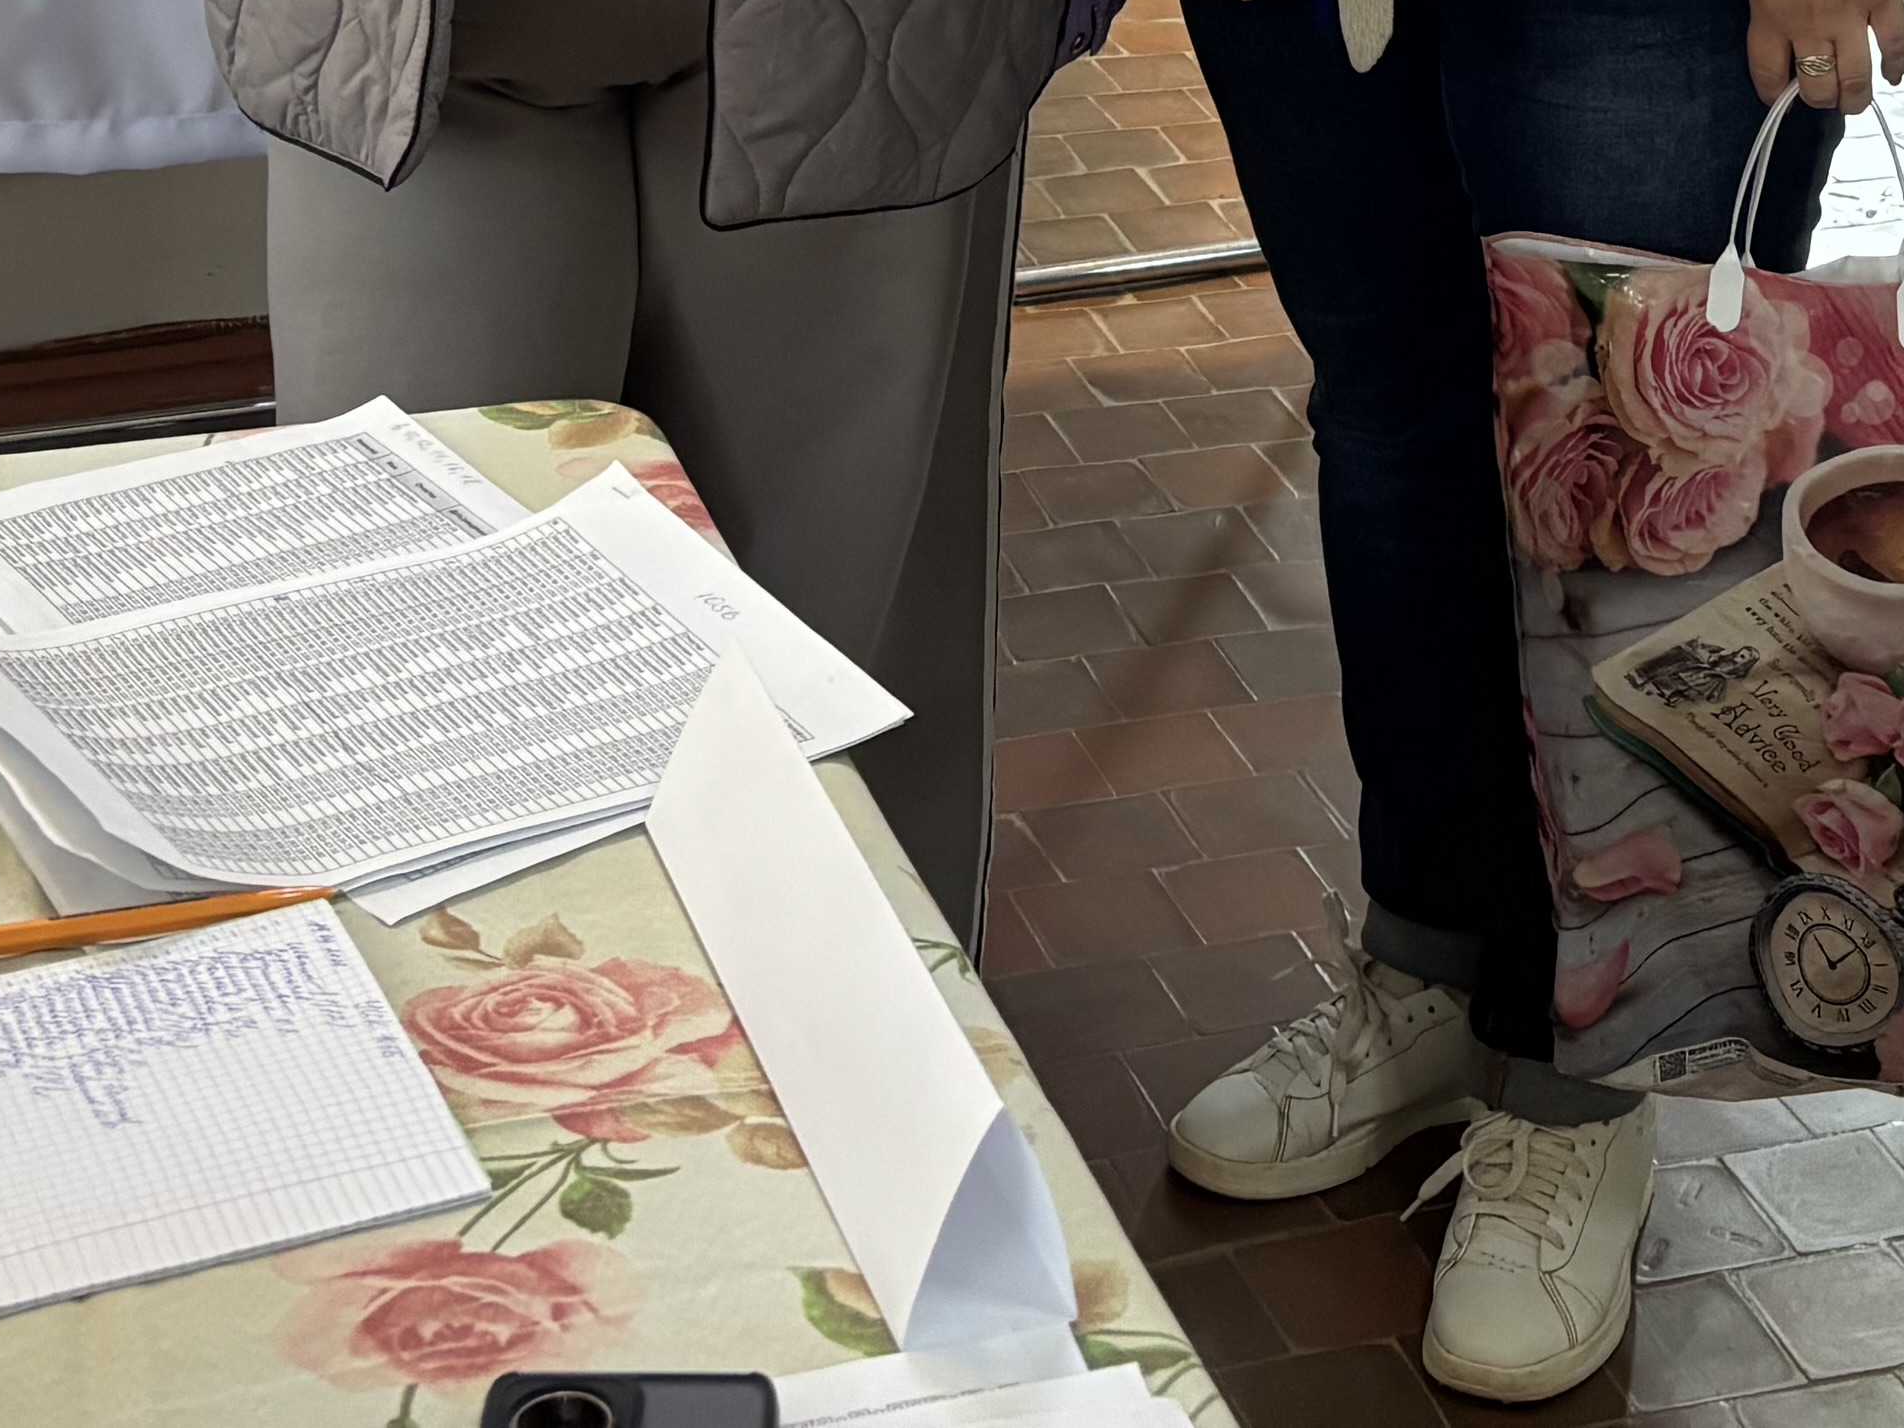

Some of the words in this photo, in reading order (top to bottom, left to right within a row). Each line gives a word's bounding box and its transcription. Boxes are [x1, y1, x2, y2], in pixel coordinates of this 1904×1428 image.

[1711, 702, 1786, 773] Advice
[1750, 680, 1787, 719] Very
[1773, 725, 1821, 773] Good
